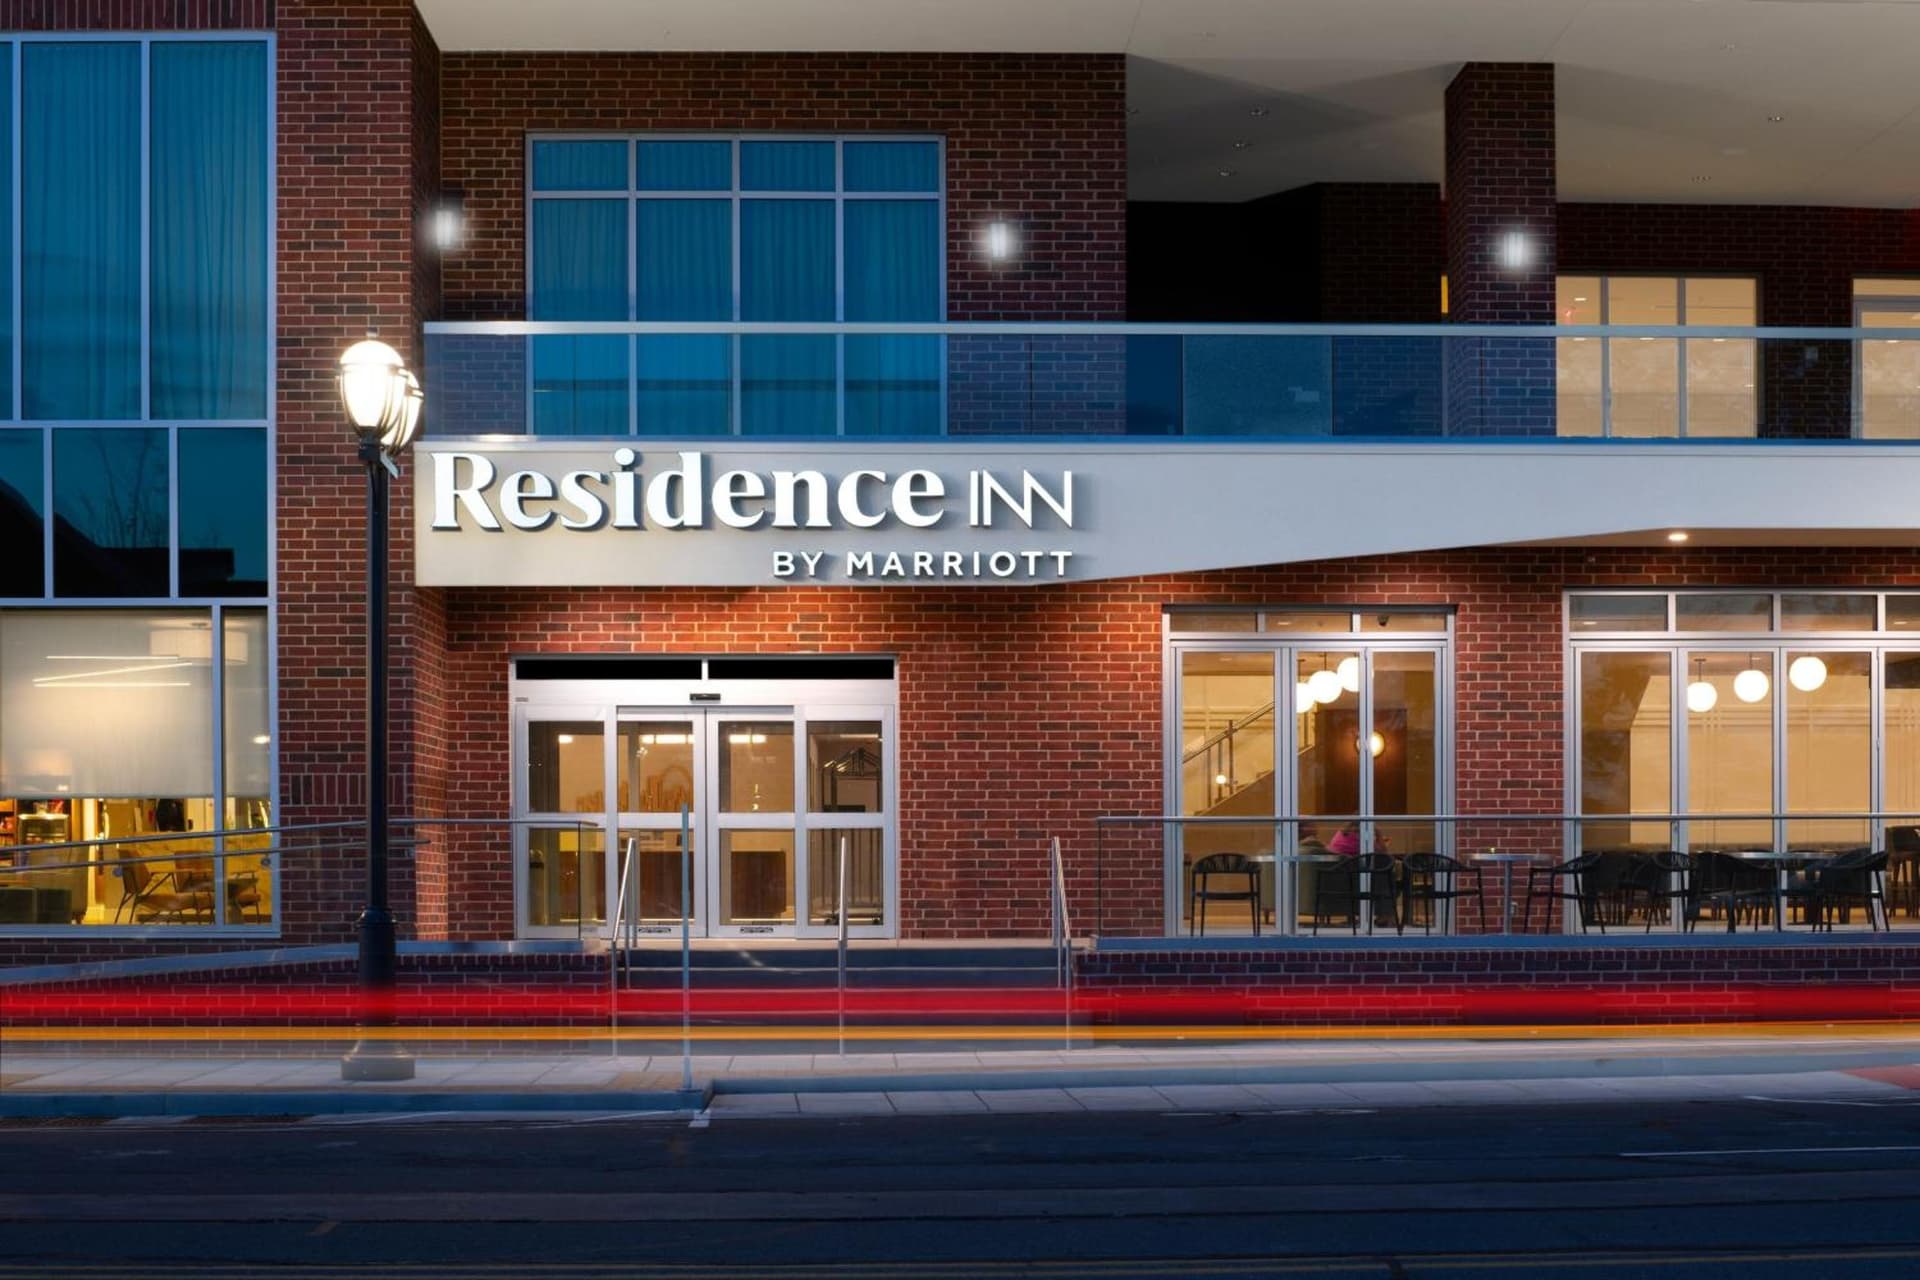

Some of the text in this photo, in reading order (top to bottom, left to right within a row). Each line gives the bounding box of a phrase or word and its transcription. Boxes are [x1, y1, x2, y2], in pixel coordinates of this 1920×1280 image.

[430, 448, 1074, 531] Residence INN
[772, 551, 1074, 577] BY MARRIOTT
